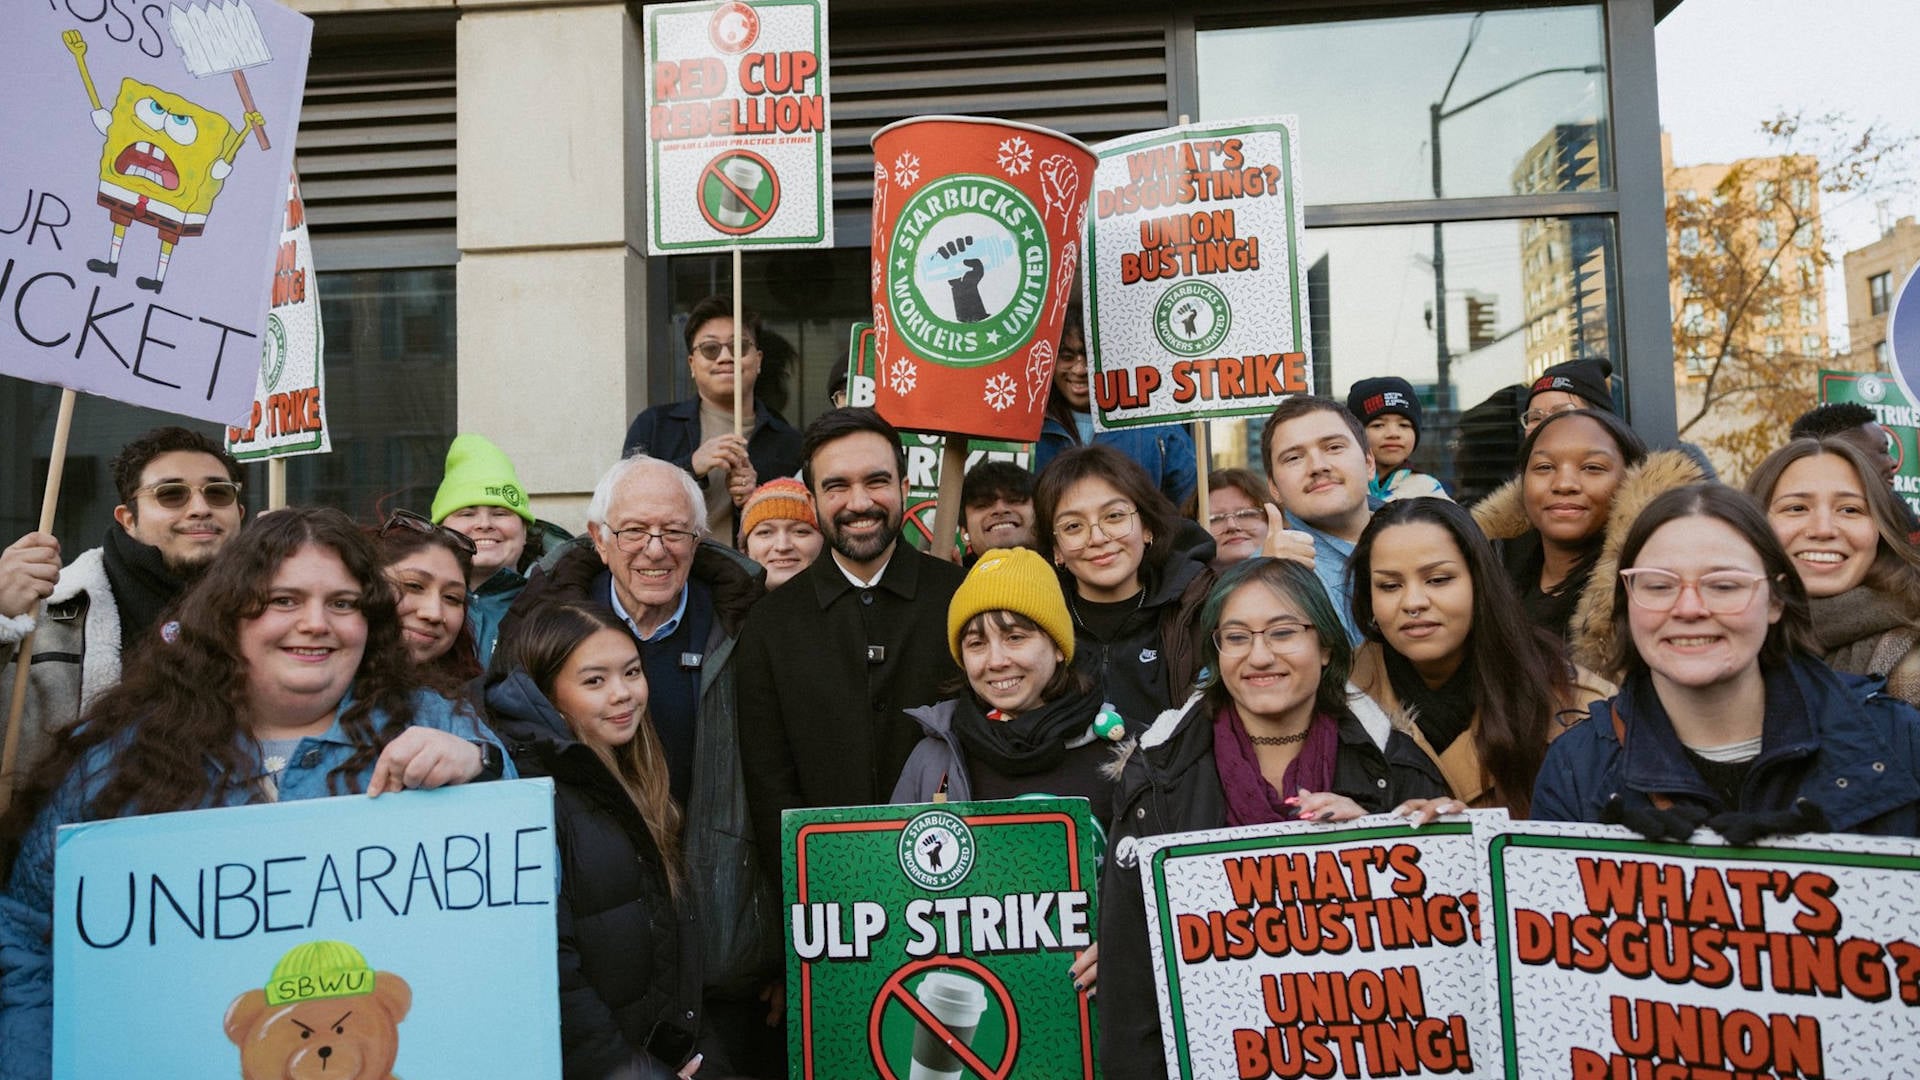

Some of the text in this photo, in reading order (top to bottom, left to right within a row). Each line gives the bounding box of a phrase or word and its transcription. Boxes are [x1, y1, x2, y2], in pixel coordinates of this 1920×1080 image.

[655, 51, 819, 100] RED CUP
[651, 95, 825, 141] REBELLION
[730, 137, 777, 147] PRACTICE
[778, 135, 814, 145] STRIKE
[1127, 139, 1244, 184] WHAT'S
[898, 186, 1027, 251] STARBUCKS
[1098, 165, 1282, 219] DISGUSTING?
[1140, 209, 1236, 250] UNION
[1121, 236, 1260, 285] BUSTING!
[894, 245, 1044, 352] WORKERS UNITED
[1163, 285, 1219, 309] STARBUCKS
[1159, 314, 1226, 352] WORKERS UNITED
[1094, 364, 1161, 411] ULP
[1172, 351, 1309, 404] STRIKE
[266, 386, 322, 438] TRIKE
[908, 815, 964, 839] STARBUCKS
[75, 826, 549, 949] UNBEARABLE
[904, 846, 971, 886] WORKERS UNITED
[1223, 844, 1427, 908] WHAT'S
[1576, 857, 1842, 937] WHAT'S
[791, 890, 1093, 963] ULP STRIKE
[1515, 908, 1920, 1006] DISGUSTING?
[278, 971, 366, 1001] SBWU
[1260, 965, 1426, 1029] UNION
[1232, 1014, 1474, 1080] BUSTING!
[1610, 994, 1825, 1078] UNION
